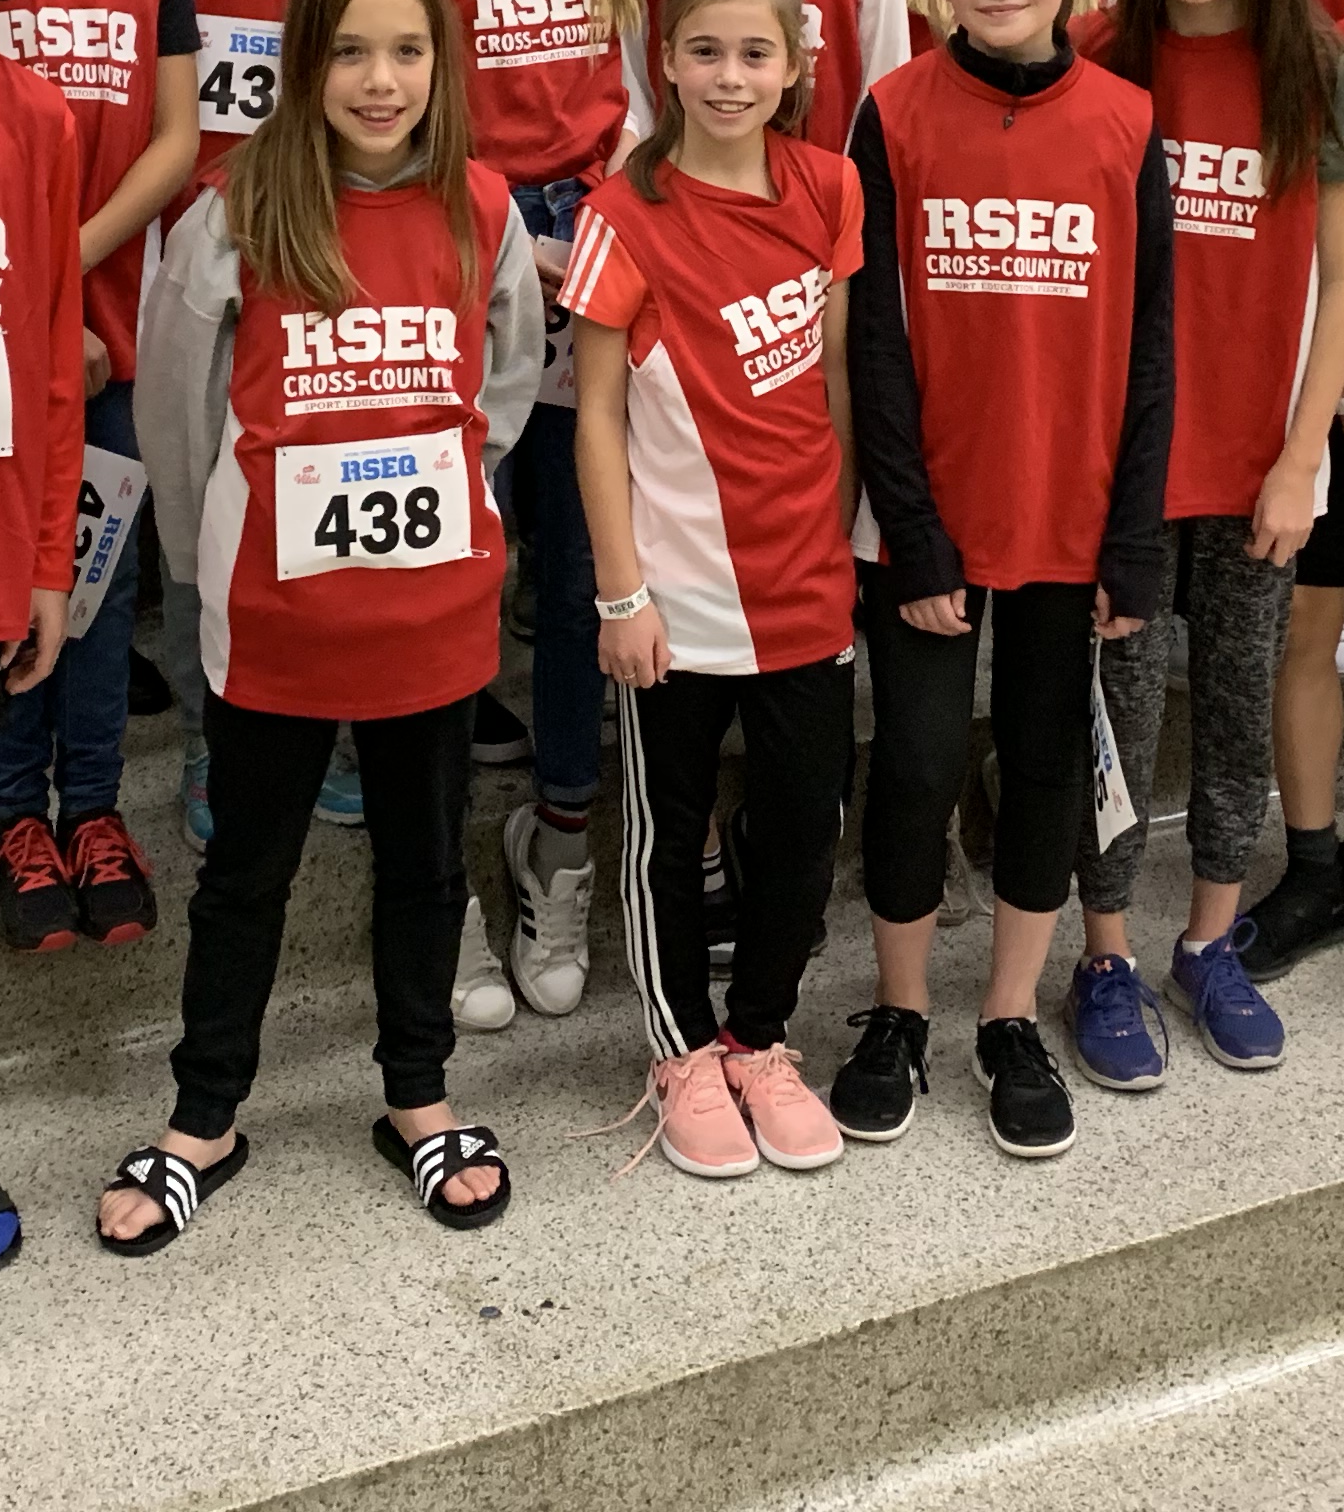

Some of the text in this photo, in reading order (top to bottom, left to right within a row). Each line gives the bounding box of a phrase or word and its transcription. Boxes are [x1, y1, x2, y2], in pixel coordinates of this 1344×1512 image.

[229, 32, 282, 57] RSE
[198, 60, 277, 120] 43
[923, 198, 1099, 255] RSEQ
[926, 254, 1091, 281] CROSS-COUNTRY
[280, 306, 461, 369] RSEQ
[719, 264, 834, 357] RSE
[743, 314, 824, 381] CROSS-CO
[340, 454, 419, 483] RSEQ
[85, 514, 122, 585] RSEQ
[314, 486, 442, 559] 438
